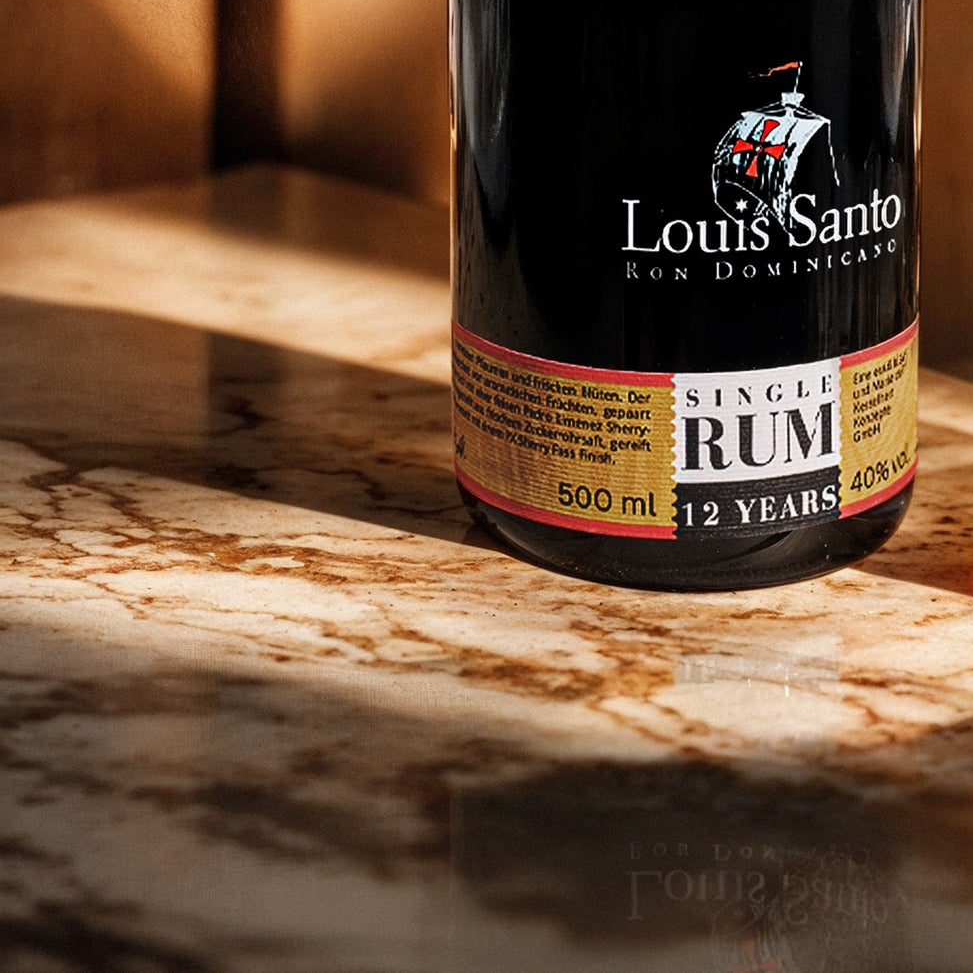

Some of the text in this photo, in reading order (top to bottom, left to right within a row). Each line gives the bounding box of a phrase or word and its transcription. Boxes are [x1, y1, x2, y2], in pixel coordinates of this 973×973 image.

[621, 188, 902, 253] Louis Santo
[628, 390, 651, 404] Der
[686, 374, 833, 408] SINGLE
[681, 400, 837, 471] RUM
[850, 459, 889, 492] 40%
[558, 482, 657, 516] 500 ml
[682, 484, 839, 527] 12 YEARS
